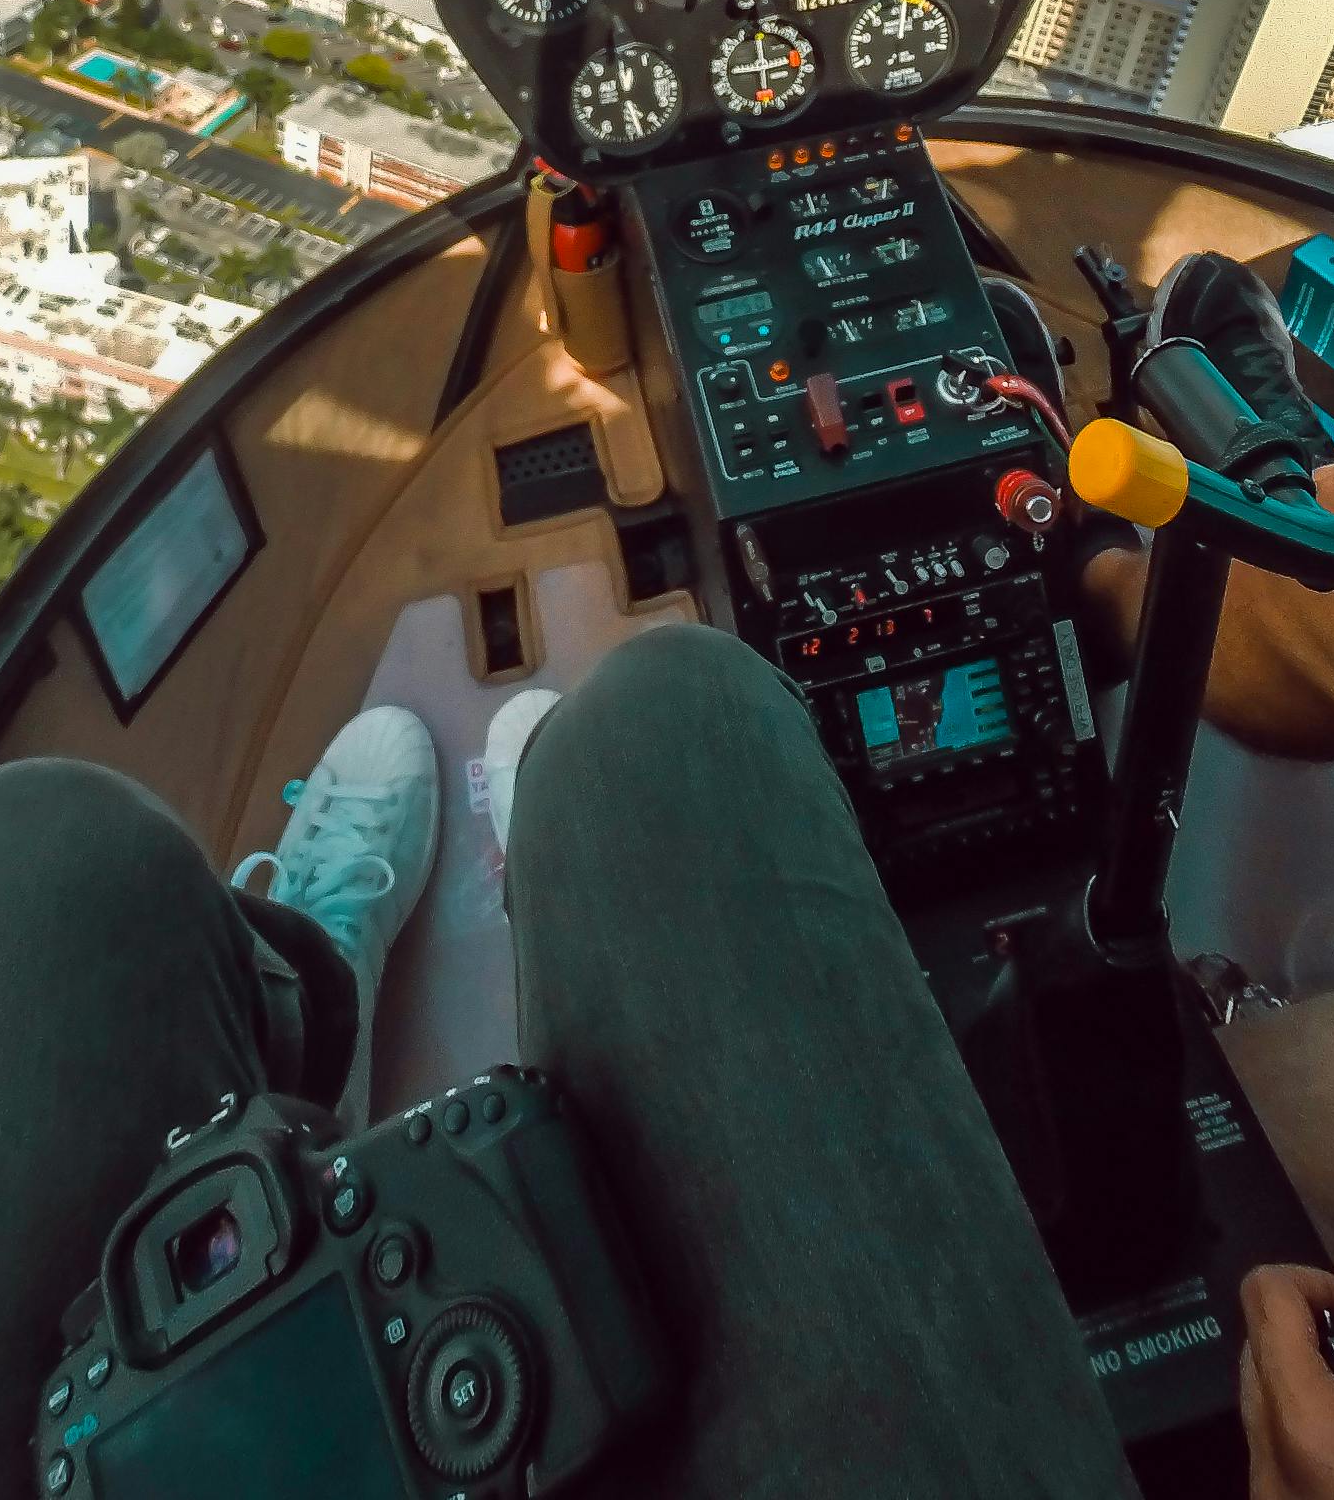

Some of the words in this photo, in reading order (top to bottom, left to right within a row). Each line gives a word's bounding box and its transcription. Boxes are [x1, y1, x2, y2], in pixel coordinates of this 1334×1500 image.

[794, 218, 837, 240] R44
[1090, 1349, 1121, 1378] NO
[1125, 1315, 1222, 1365] SMOKING
[453, 1380, 475, 1407] SET
